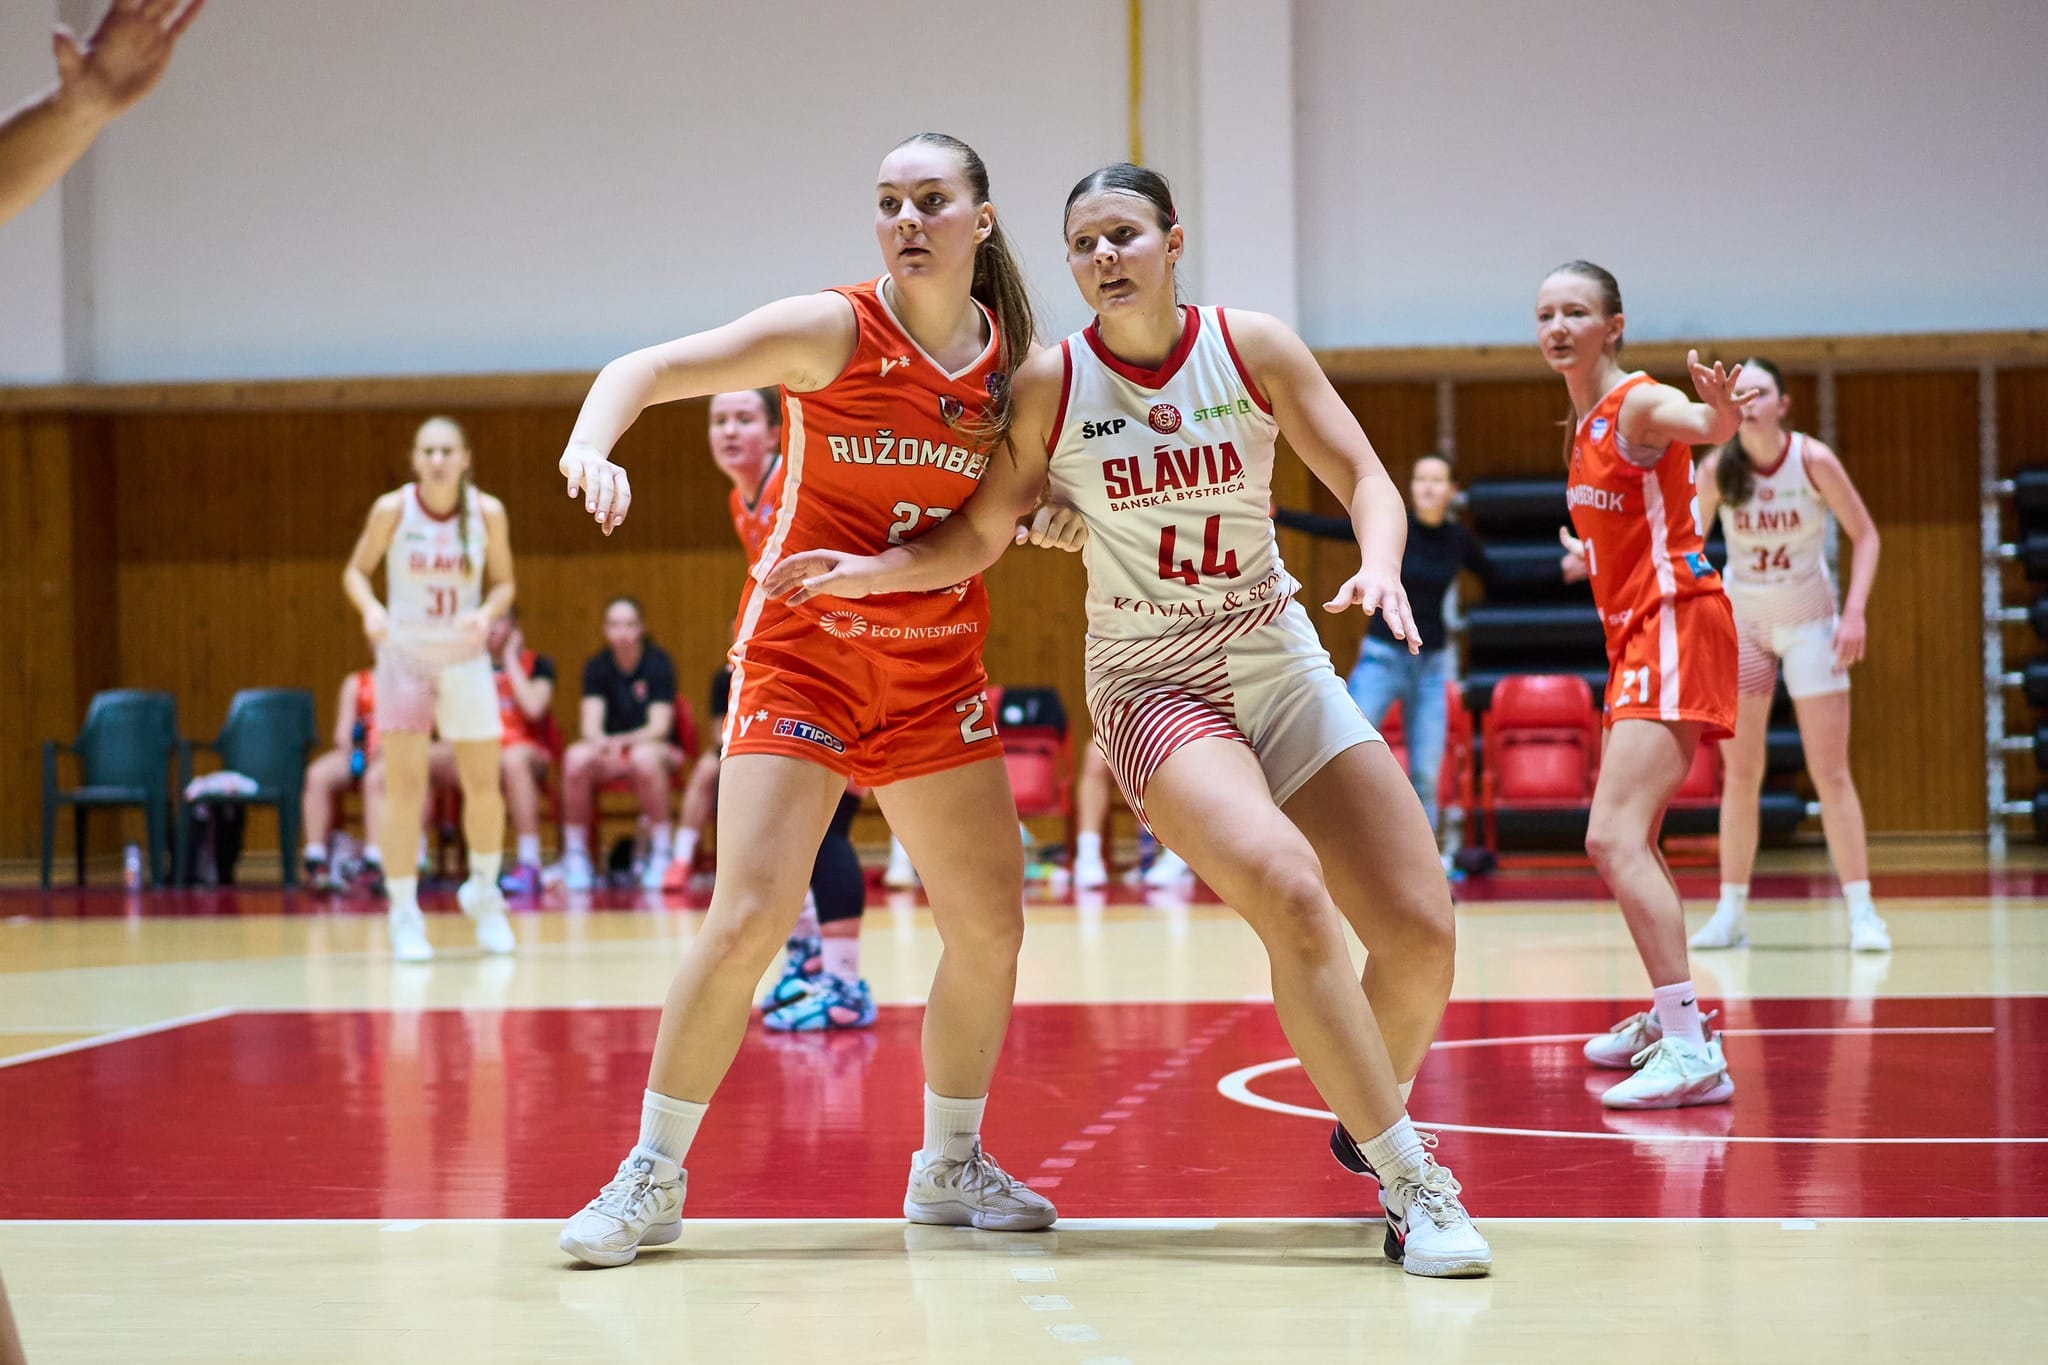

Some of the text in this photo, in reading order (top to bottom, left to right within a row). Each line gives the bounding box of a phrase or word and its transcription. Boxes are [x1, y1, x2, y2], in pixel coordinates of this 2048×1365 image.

[1193, 403, 1233, 422] STEFE
[1082, 419, 1127, 440] ŠKP
[1102, 441, 1246, 500] SLÁVIA
[1110, 481, 1246, 512] BANSKÁ BYSTRICA
[1158, 513, 1242, 586] 44
[1750, 545, 1791, 572] 34
[426, 584, 458, 618] 31
[1222, 591, 1243, 612] &
[800, 724, 843, 751] TIPOS
